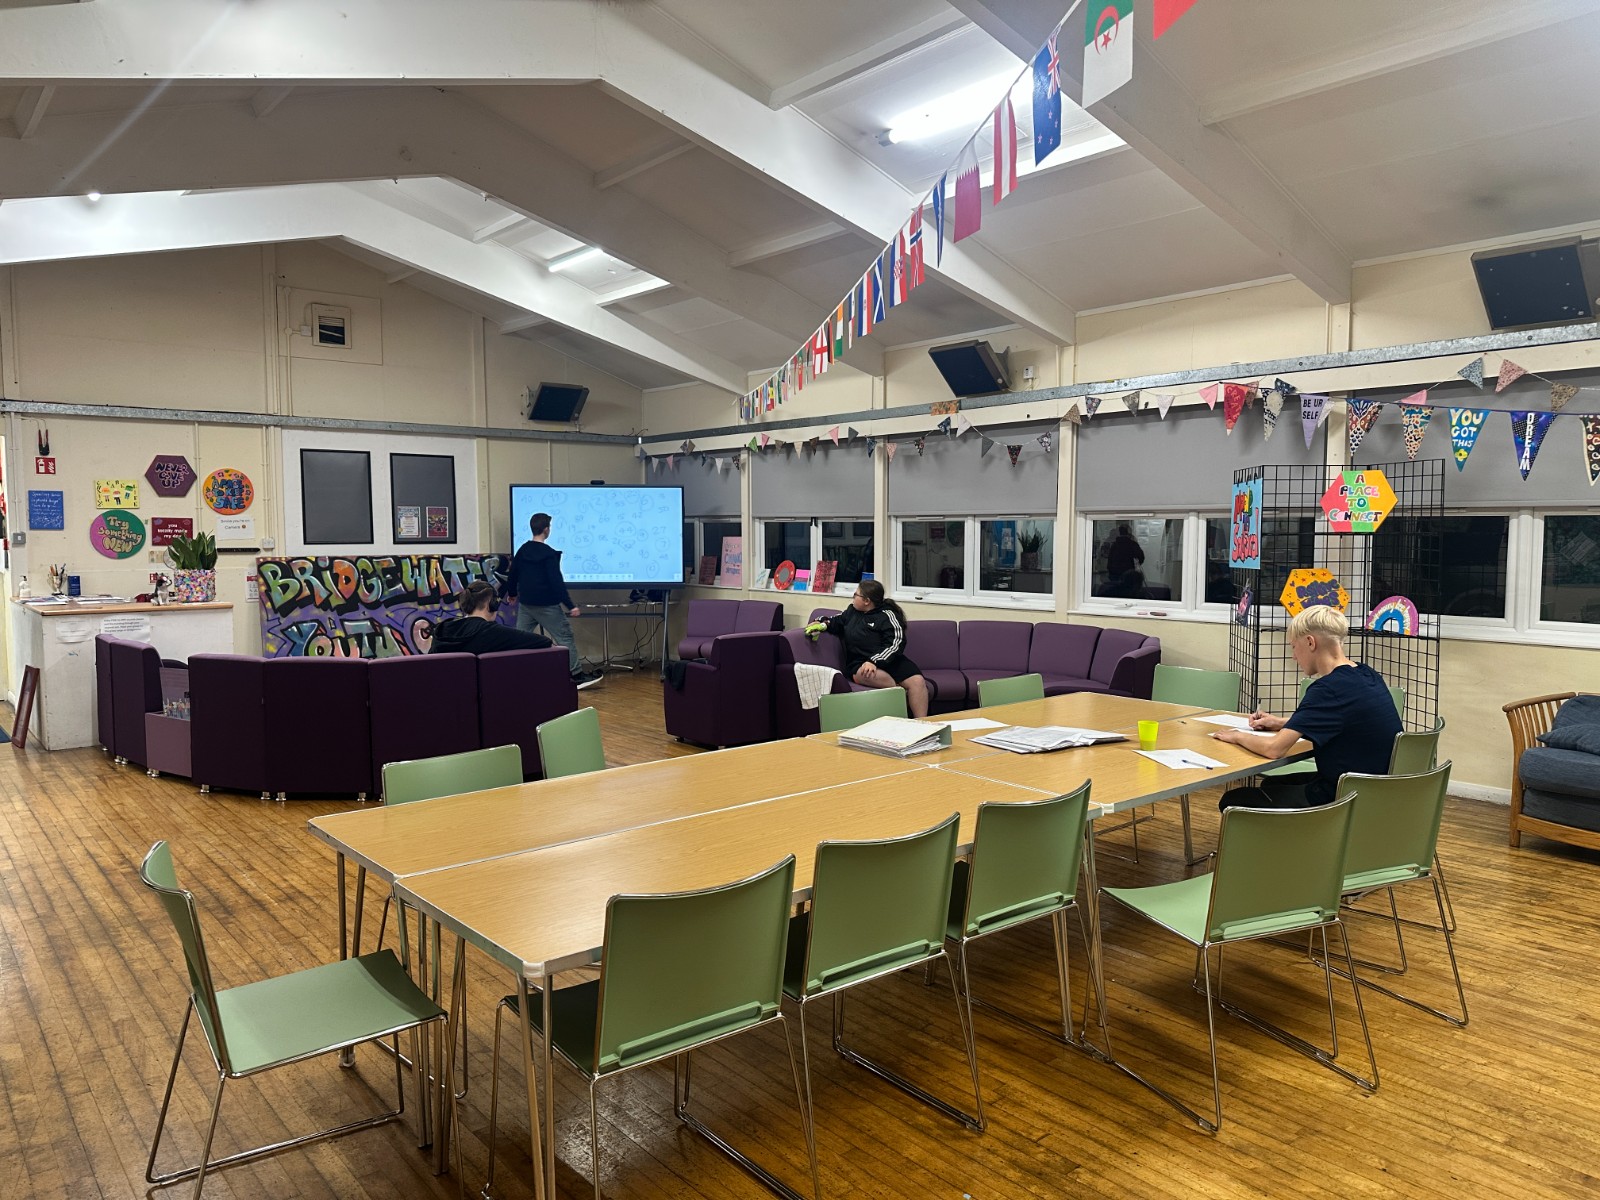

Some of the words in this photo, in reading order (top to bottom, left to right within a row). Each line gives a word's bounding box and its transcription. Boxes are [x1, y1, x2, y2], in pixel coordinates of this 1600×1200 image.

[1225, 384, 1241, 420] CREATE
[1302, 398, 1311, 408] BE
[1313, 398, 1323, 407] UR
[1302, 410, 1319, 420] SELF
[1449, 408, 1483, 426] YOU
[1451, 426, 1477, 438] GOT
[1452, 439, 1474, 448] THIS
[1520, 412, 1535, 470] DREAM
[155, 462, 189, 475] NEVER
[158, 471, 184, 481] GIVE
[1355, 474, 1365, 484] A
[161, 480, 180, 489] UP
[1339, 485, 1379, 497] PLACE
[213, 496, 246, 510] SAFE
[1345, 497, 1367, 508] TO
[1328, 508, 1383, 523] CONNECT
[107, 516, 130, 530] Try
[98, 526, 143, 546] Something
[102, 537, 133, 553] NEW
